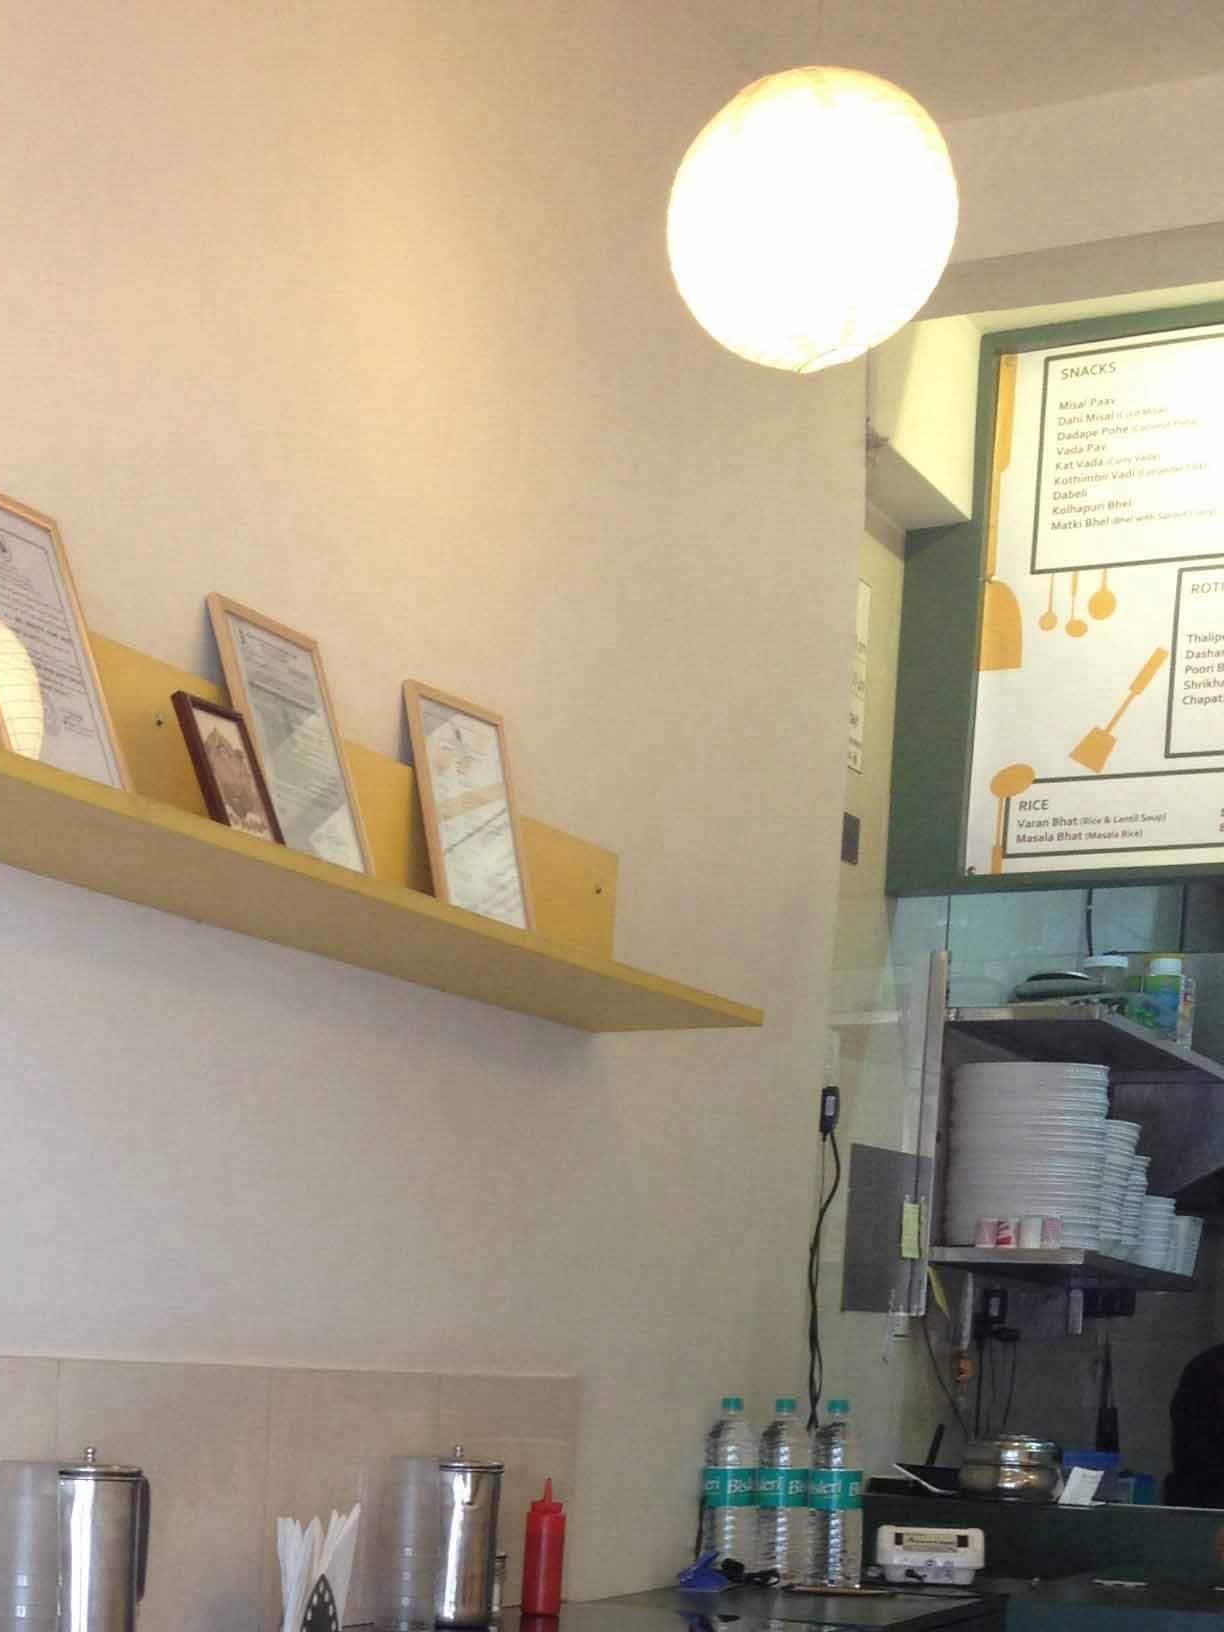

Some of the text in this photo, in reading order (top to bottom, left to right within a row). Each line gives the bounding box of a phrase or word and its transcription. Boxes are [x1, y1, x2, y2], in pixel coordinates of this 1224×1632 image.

[1061, 361, 1117, 380] SNACKS
[1058, 399, 1087, 411] Misal
[1086, 411, 1114, 423] Misal
[1102, 424, 1129, 435] Pohe
[1056, 442, 1106, 457] Vada Pav
[1076, 457, 1103, 469] Vada
[1111, 468, 1135, 480] Vadi
[1052, 488, 1088, 501] Dabeli
[1107, 498, 1132, 510] Bhel
[1050, 517, 1082, 531] Matki
[1085, 515, 1109, 528] Bhel
[1185, 663, 1214, 675] Poori
[1183, 694, 1224, 706] Chapat
[1018, 799, 1049, 812] RICE
[1017, 817, 1049, 829] Varan
[1052, 815, 1078, 827] Bhat
[1016, 831, 1054, 844] Masala
[1057, 829, 1083, 842] Bhat
[1121, 828, 1144, 839] Rice)
